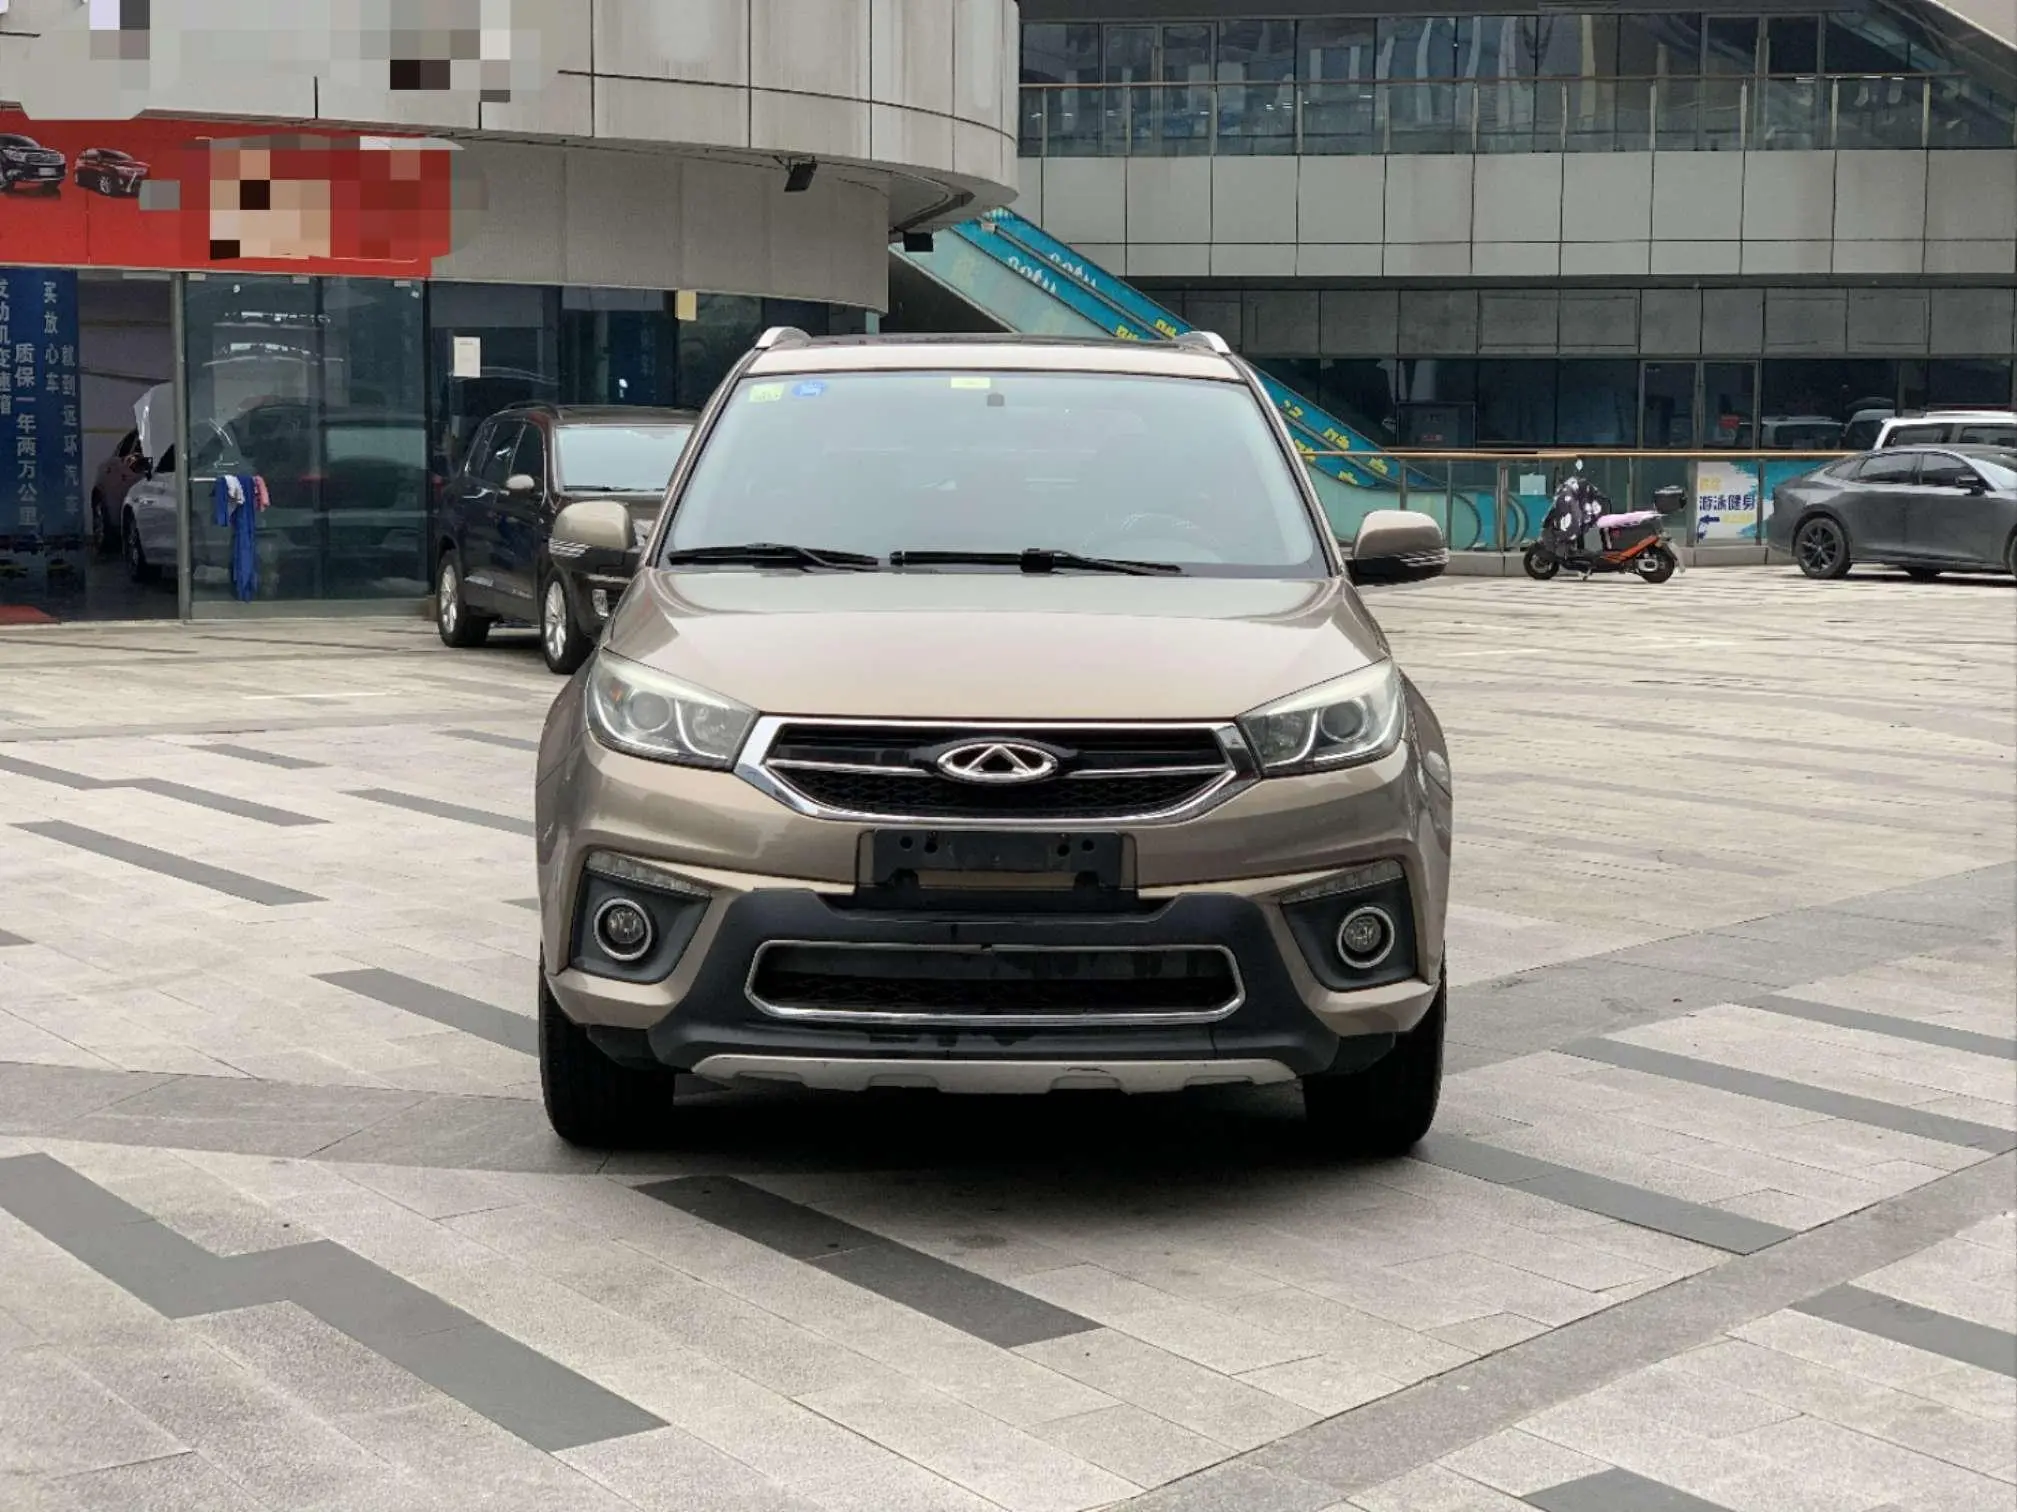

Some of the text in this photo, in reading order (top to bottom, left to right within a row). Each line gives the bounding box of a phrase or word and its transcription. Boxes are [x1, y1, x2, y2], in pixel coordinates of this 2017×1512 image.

[43, 281, 60, 394] 买放心车
[15, 343, 37, 526] 质保一年两万公里
[1699, 493, 1755, 512] 游泳健身
